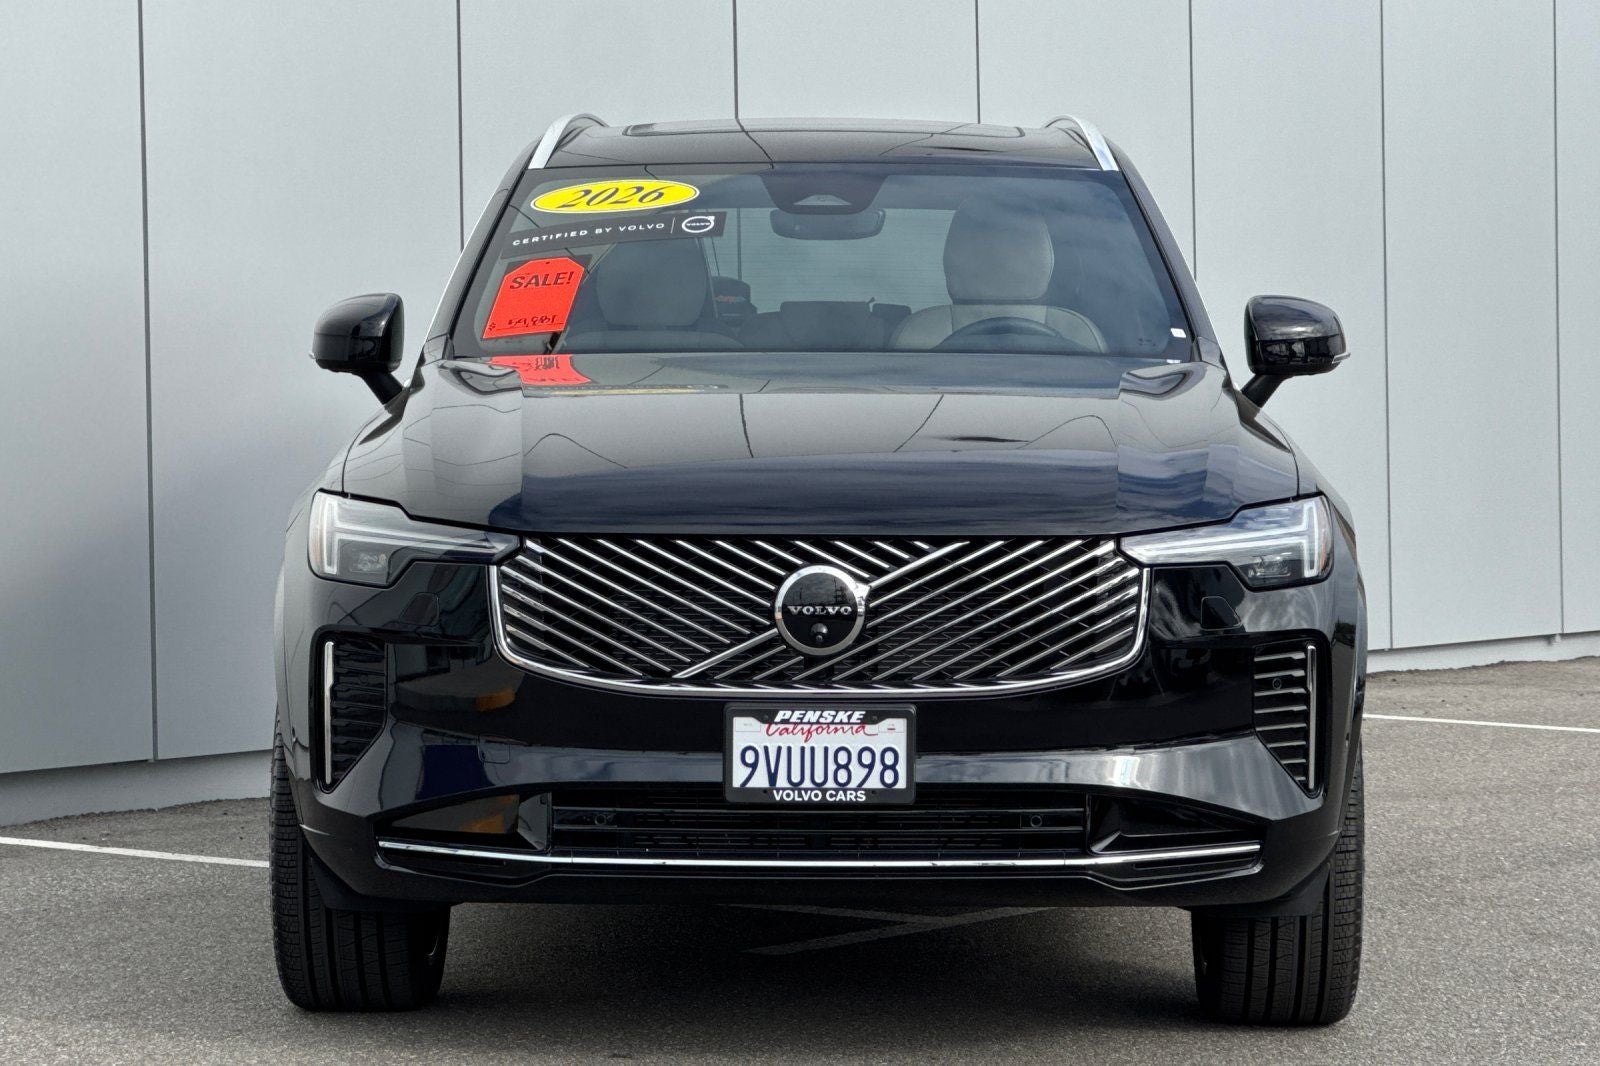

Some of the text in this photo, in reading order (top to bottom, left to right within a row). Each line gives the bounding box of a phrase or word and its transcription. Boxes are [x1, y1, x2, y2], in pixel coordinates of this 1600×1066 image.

[557, 184, 673, 209] 2026
[512, 222, 665, 246] CERTIFIED BY VOLVO
[510, 271, 574, 289] SALE!
[787, 606, 852, 615] VOLVO
[774, 711, 866, 723] PENSKE
[766, 723, 878, 743] California
[740, 745, 899, 788] 9VUU898
[773, 790, 866, 801] VOLVO CARS
